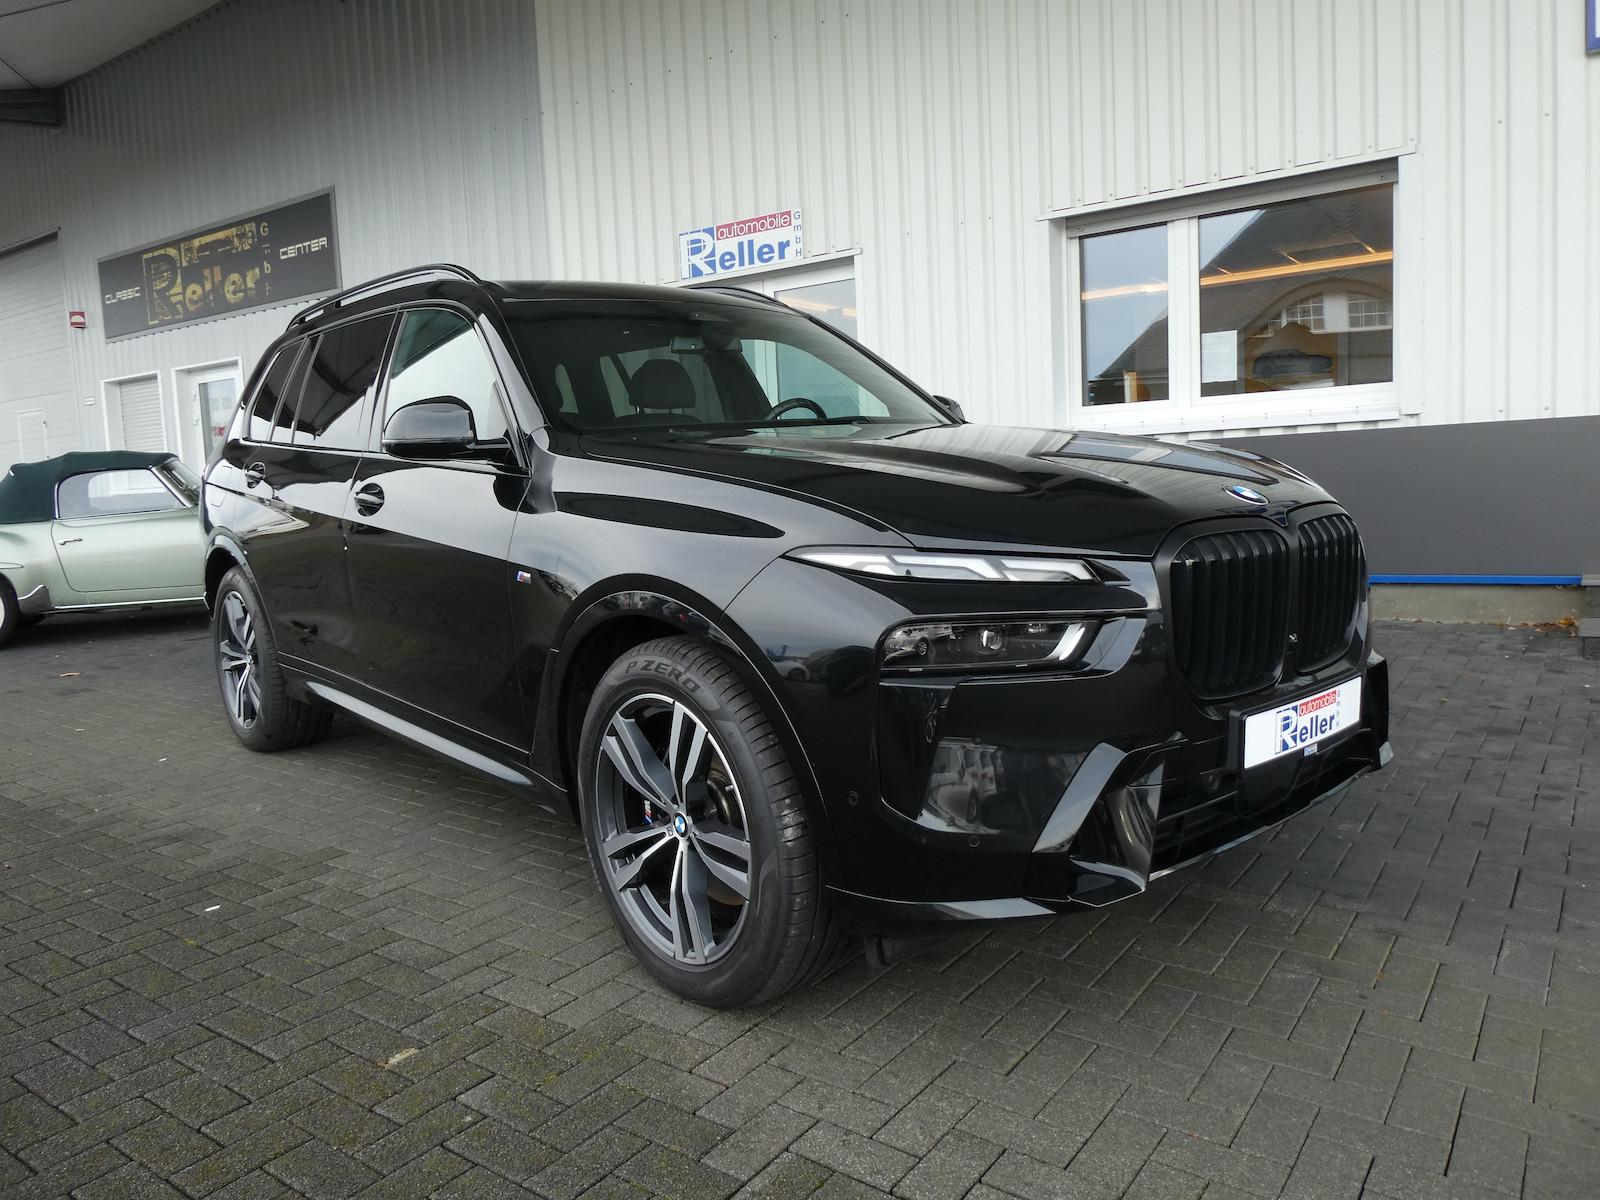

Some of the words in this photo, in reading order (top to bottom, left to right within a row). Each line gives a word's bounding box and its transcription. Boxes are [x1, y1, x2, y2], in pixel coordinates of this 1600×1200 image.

[717, 213, 791, 240] automobile
[279, 236, 328, 260] CENTER
[678, 226, 791, 280] Reller
[105, 286, 141, 304] CLASSIC
[640, 659, 702, 693] ZERO
[1299, 690, 1337, 716] automobile
[1275, 704, 1335, 755] Reller
